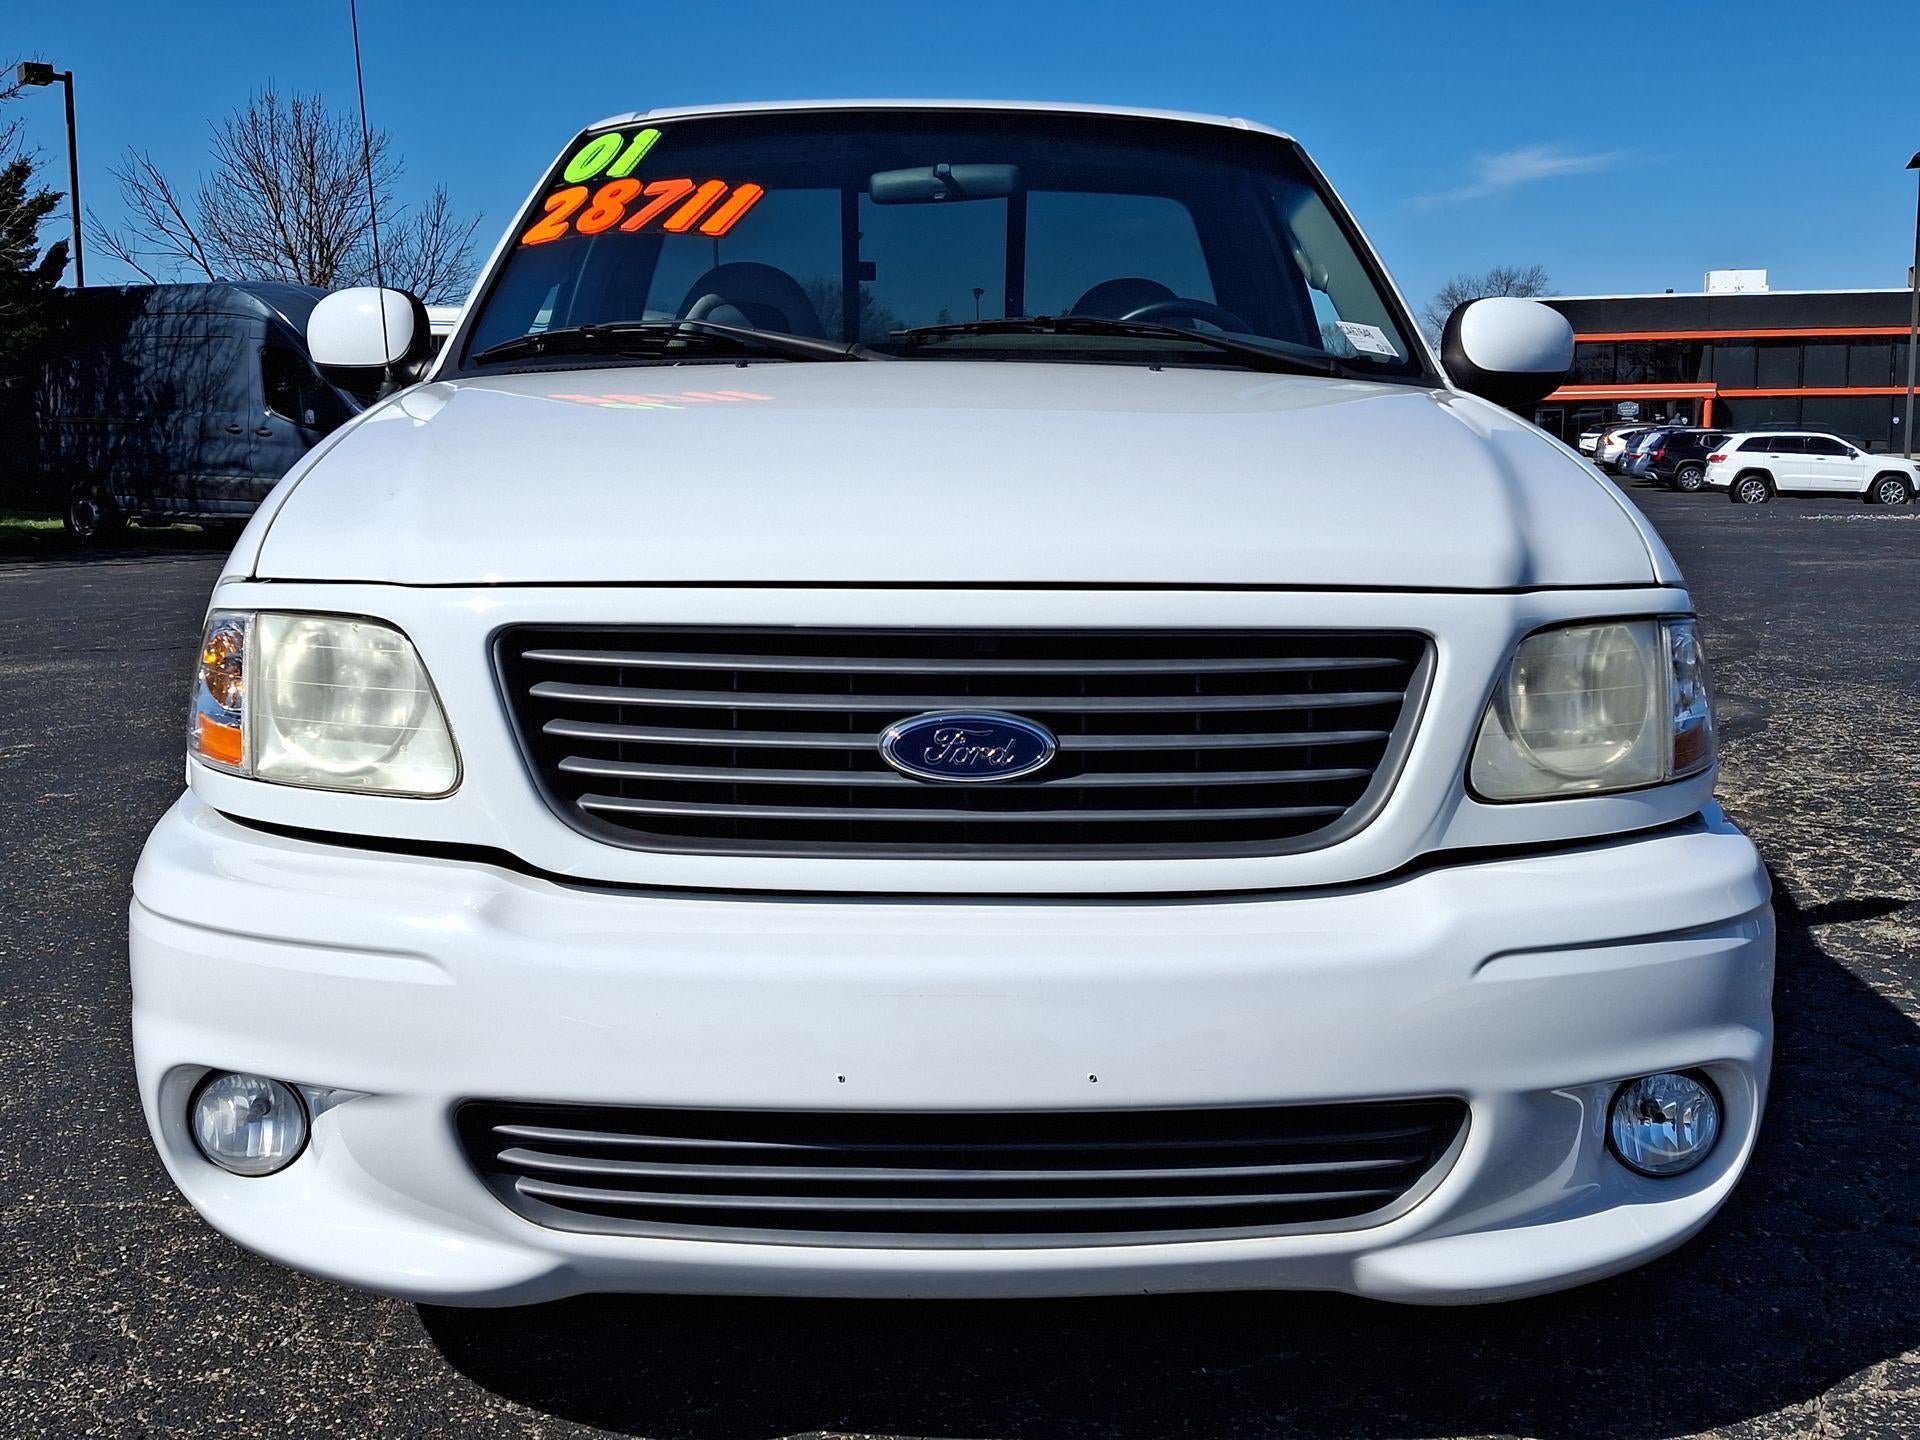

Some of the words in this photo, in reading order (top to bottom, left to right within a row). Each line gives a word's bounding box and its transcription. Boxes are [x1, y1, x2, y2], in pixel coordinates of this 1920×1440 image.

[564, 128, 662, 184] 01
[521, 178, 765, 246] 28711
[923, 727, 1016, 766] Ford
